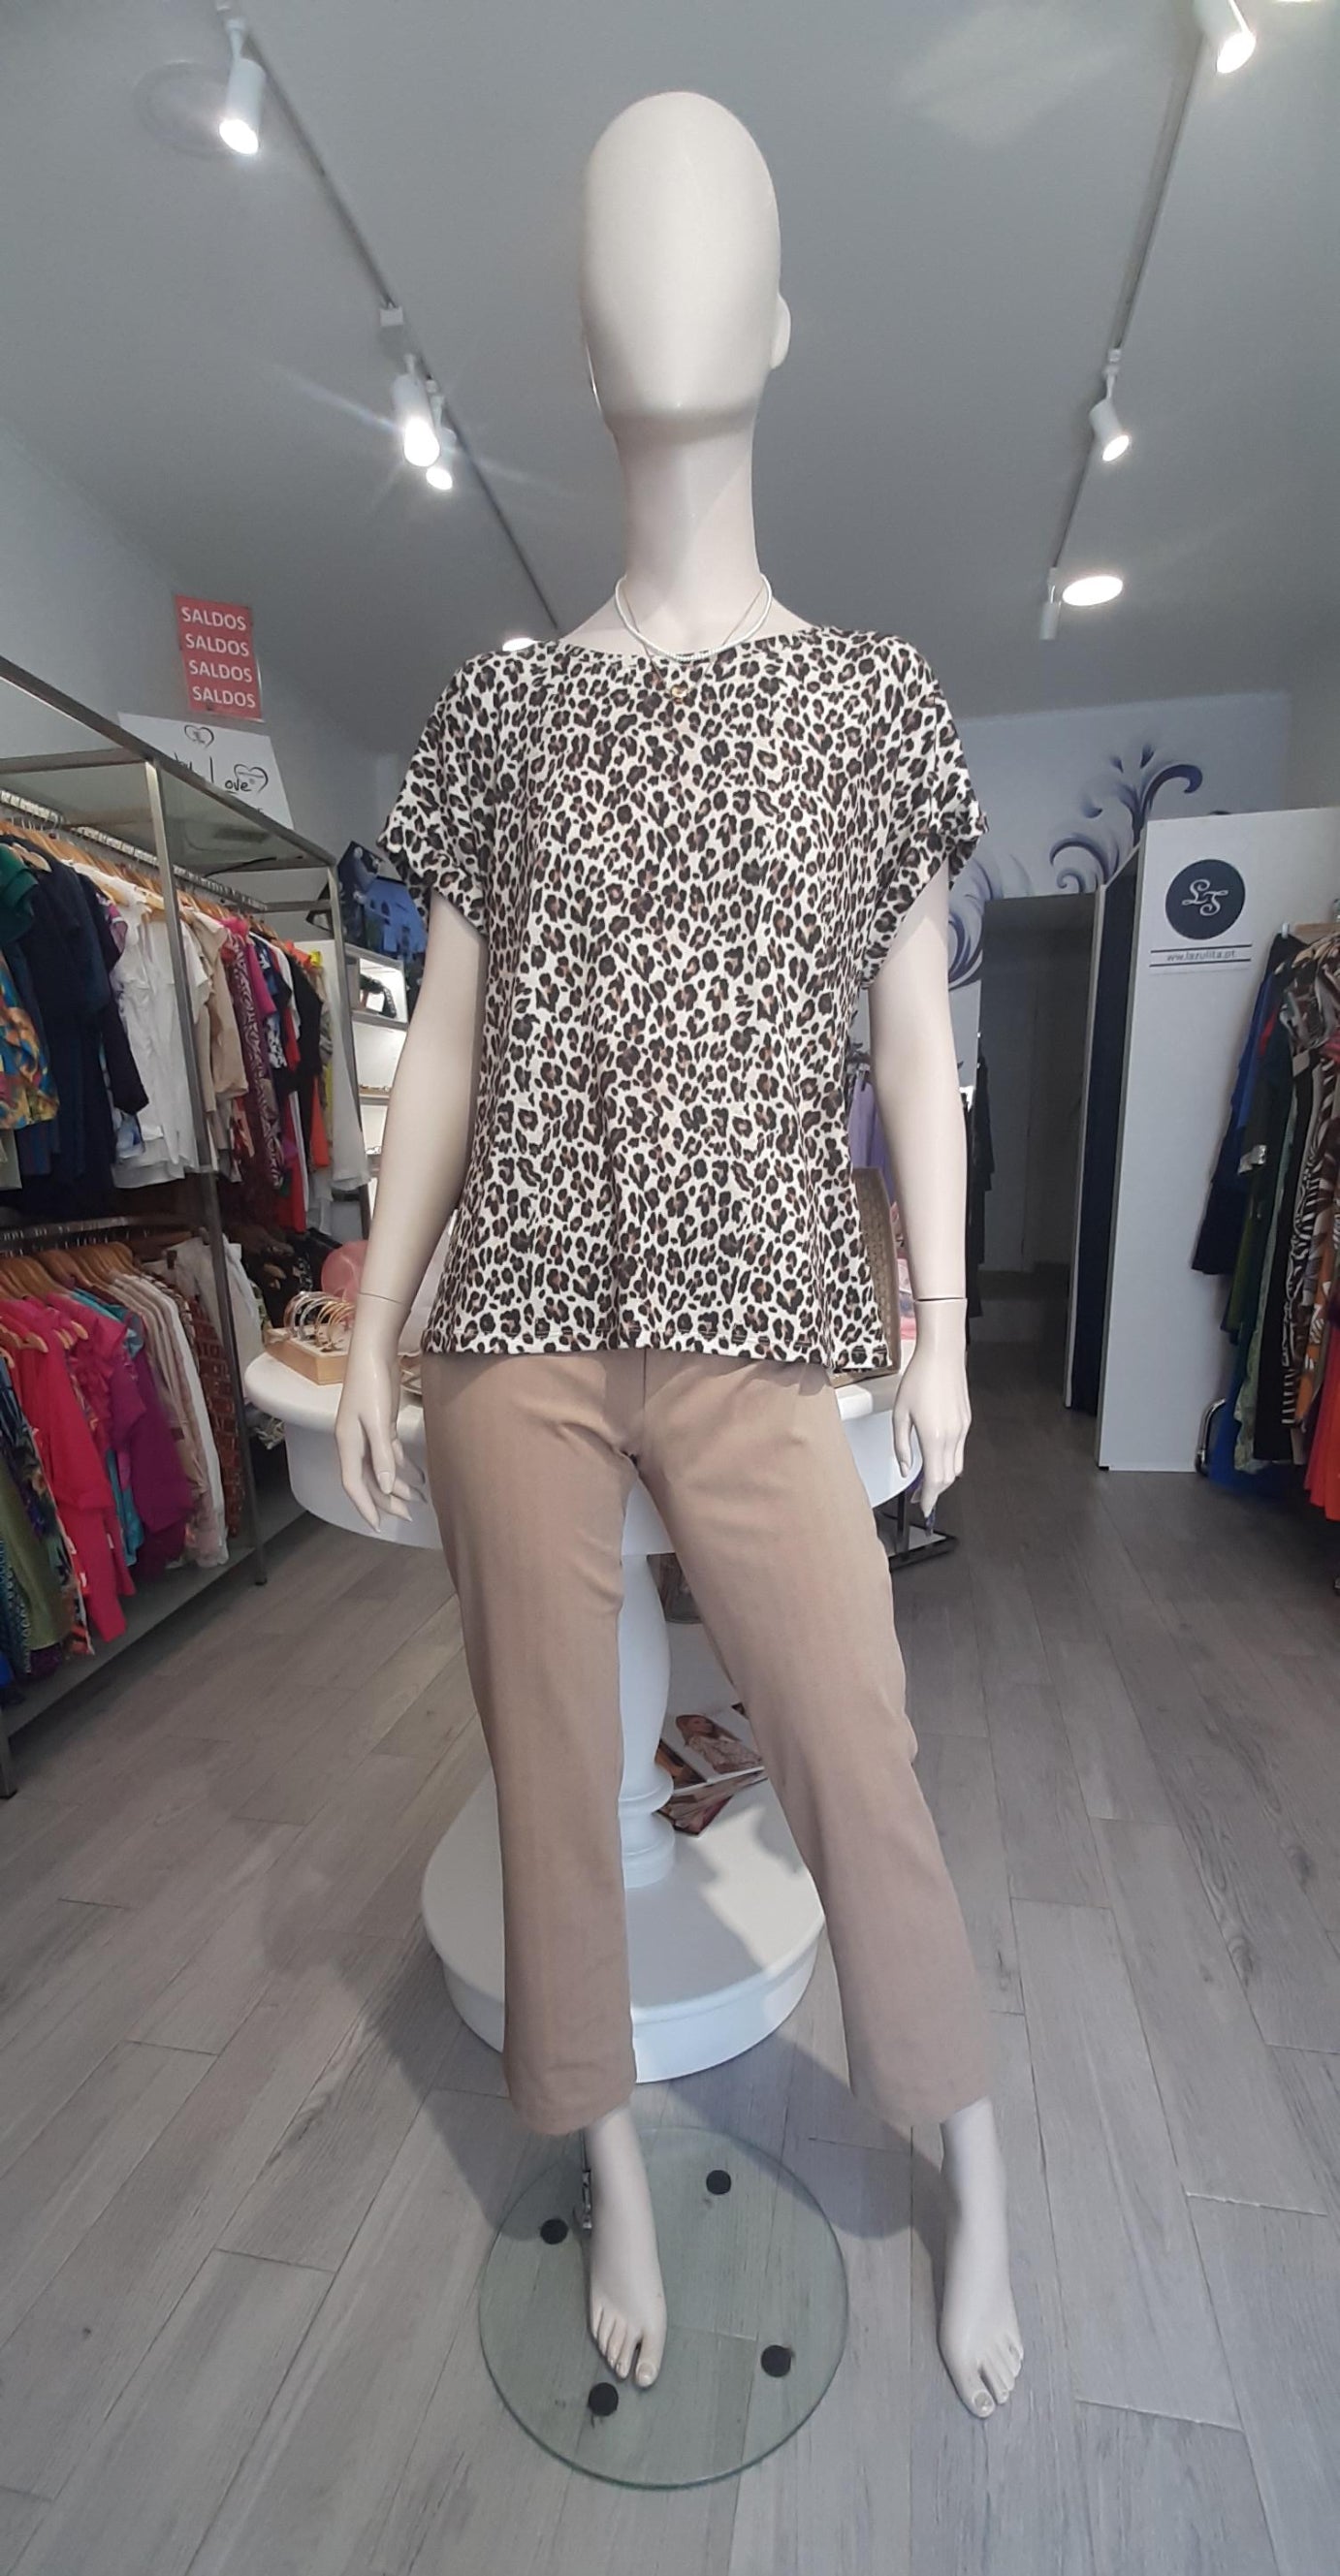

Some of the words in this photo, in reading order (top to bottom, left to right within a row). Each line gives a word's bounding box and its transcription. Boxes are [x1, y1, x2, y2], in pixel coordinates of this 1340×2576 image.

[180, 606, 247, 631] SALDOS
[184, 633, 250, 657] SALDOS
[188, 659, 253, 684] SALDOS
[192, 685, 256, 709] SALDOS
